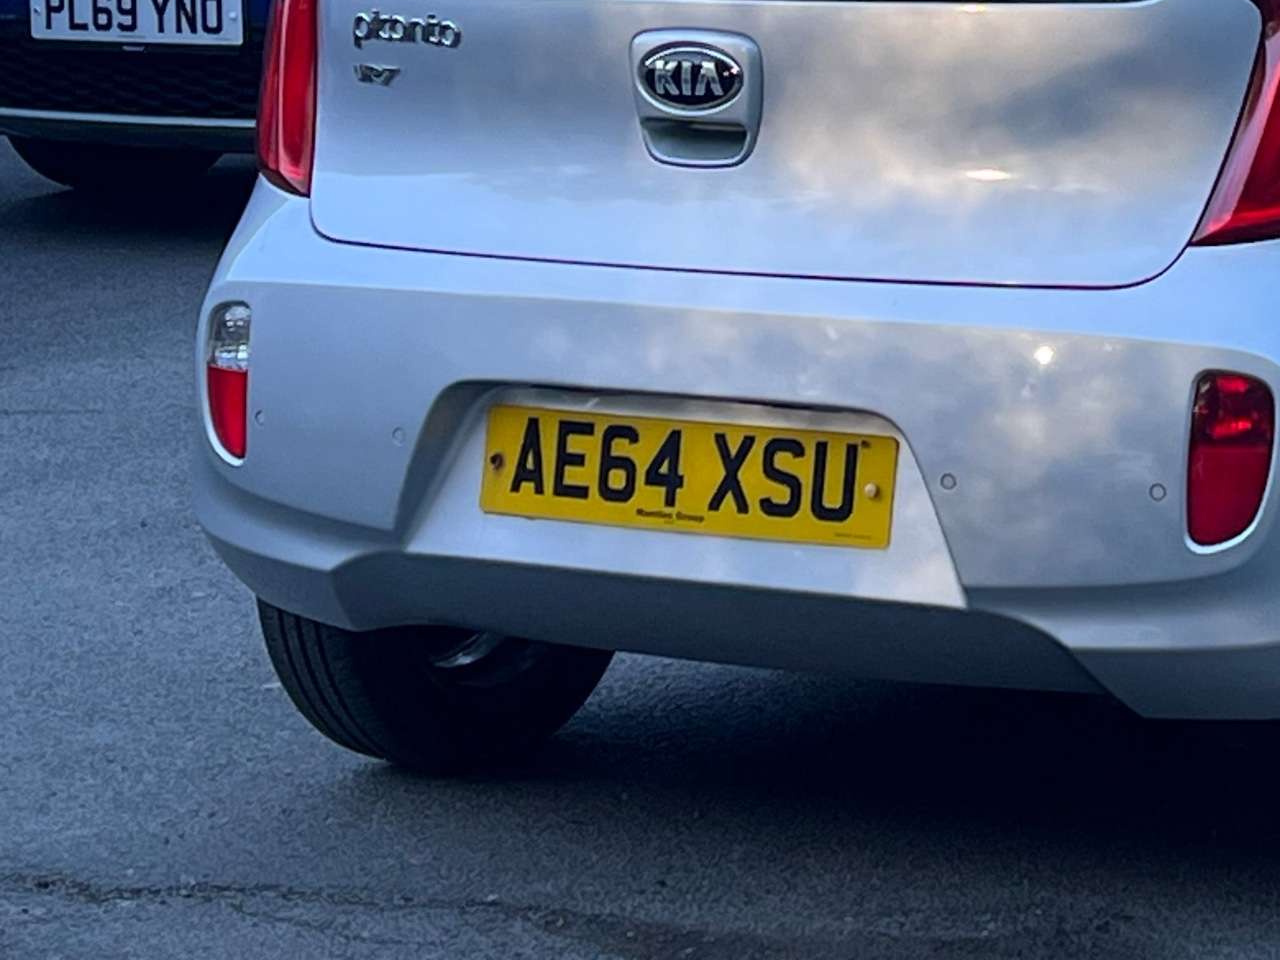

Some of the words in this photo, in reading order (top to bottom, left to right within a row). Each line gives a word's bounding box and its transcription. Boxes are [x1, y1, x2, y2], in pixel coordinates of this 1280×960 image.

[649, 59, 725, 96] KIA
[509, 416, 685, 508] AE64
[707, 433, 860, 523] XSU
